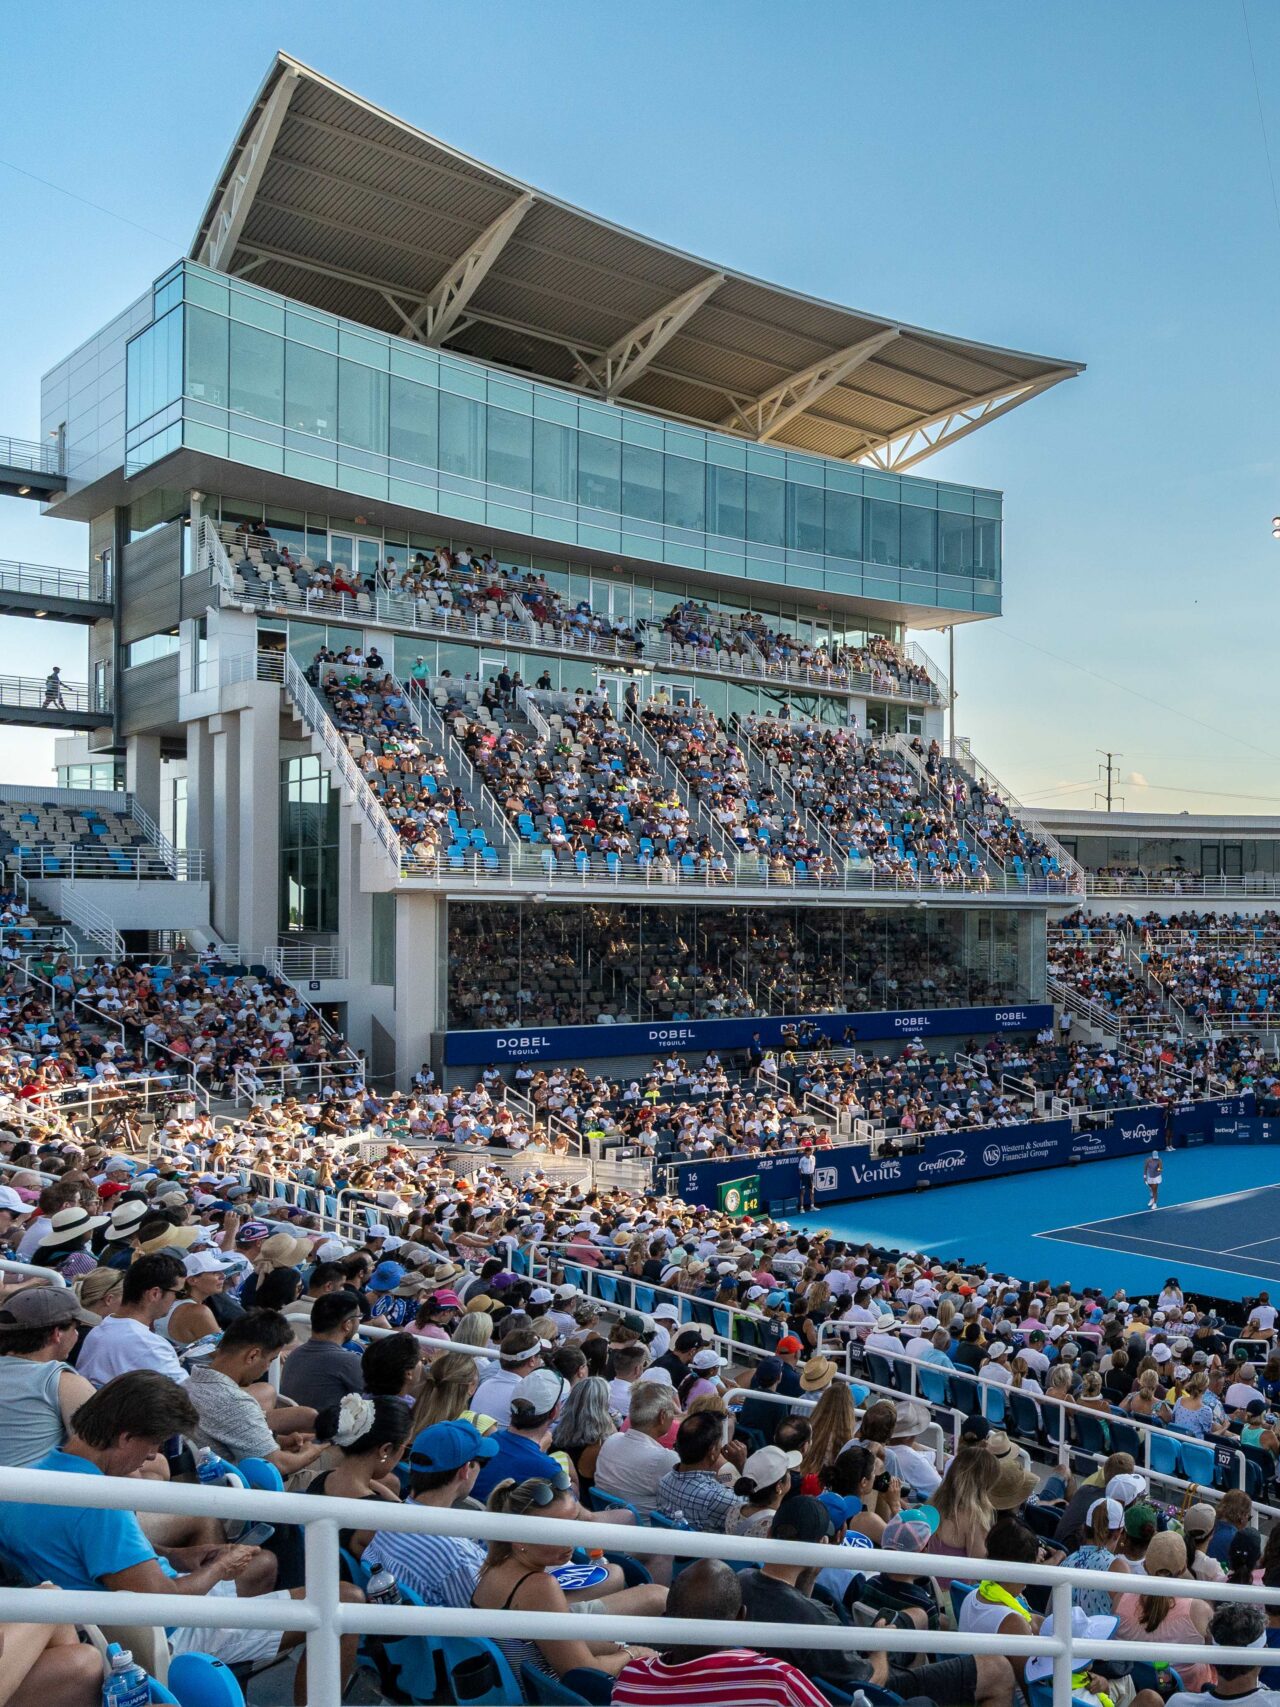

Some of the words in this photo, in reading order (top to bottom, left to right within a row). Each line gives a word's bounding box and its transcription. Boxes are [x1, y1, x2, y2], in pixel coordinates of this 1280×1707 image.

[894, 1017, 931, 1027] DOBEL
[996, 1012, 1028, 1021] DOBEL
[648, 1028, 696, 1040] DOBEL
[496, 1036, 550, 1049] DOBEL
[658, 1039, 687, 1047] TEQUILA
[507, 1047, 540, 1056] TEQUILA
[1132, 1124, 1159, 1143] Kroger
[1000, 1144, 1025, 1154] Western
[1025, 1142, 1031, 1150] &
[1032, 1140, 1058, 1150] Southern
[1001, 1151, 1029, 1162] Financial
[1029, 1149, 1049, 1160] Group
[687, 1173, 698, 1182] 16
[851, 1164, 902, 1184] Venus
[1218, 1454, 1231, 1465] 107
